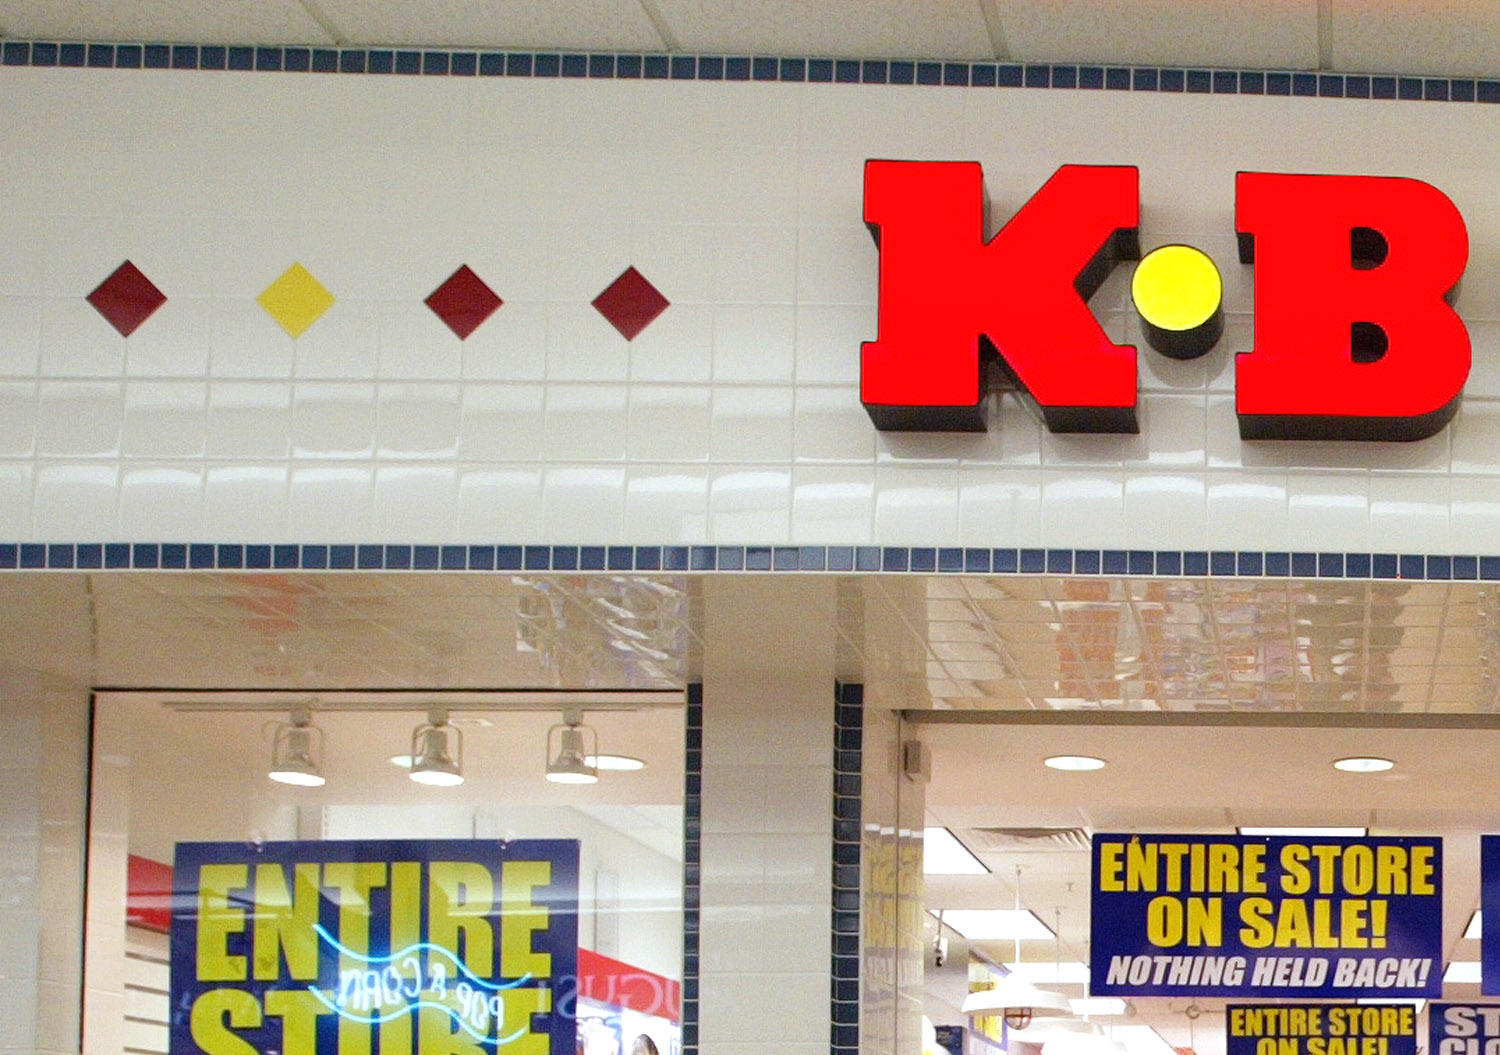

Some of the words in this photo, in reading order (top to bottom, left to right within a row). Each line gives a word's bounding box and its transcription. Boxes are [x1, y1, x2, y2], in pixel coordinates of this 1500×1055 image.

[1101, 842, 1266, 896] ENTIRE
[1280, 845, 1435, 895] STORE
[195, 861, 551, 980] ENTIRE
[1146, 896, 1224, 949] ON
[1239, 897, 1388, 949] SALE!
[1107, 954, 1243, 989] NOTHING
[1250, 957, 1326, 989] HELD
[1335, 957, 1432, 989] BACK!
[1231, 1009, 1321, 1037] ENTIRE
[1329, 1009, 1413, 1037] STORE
